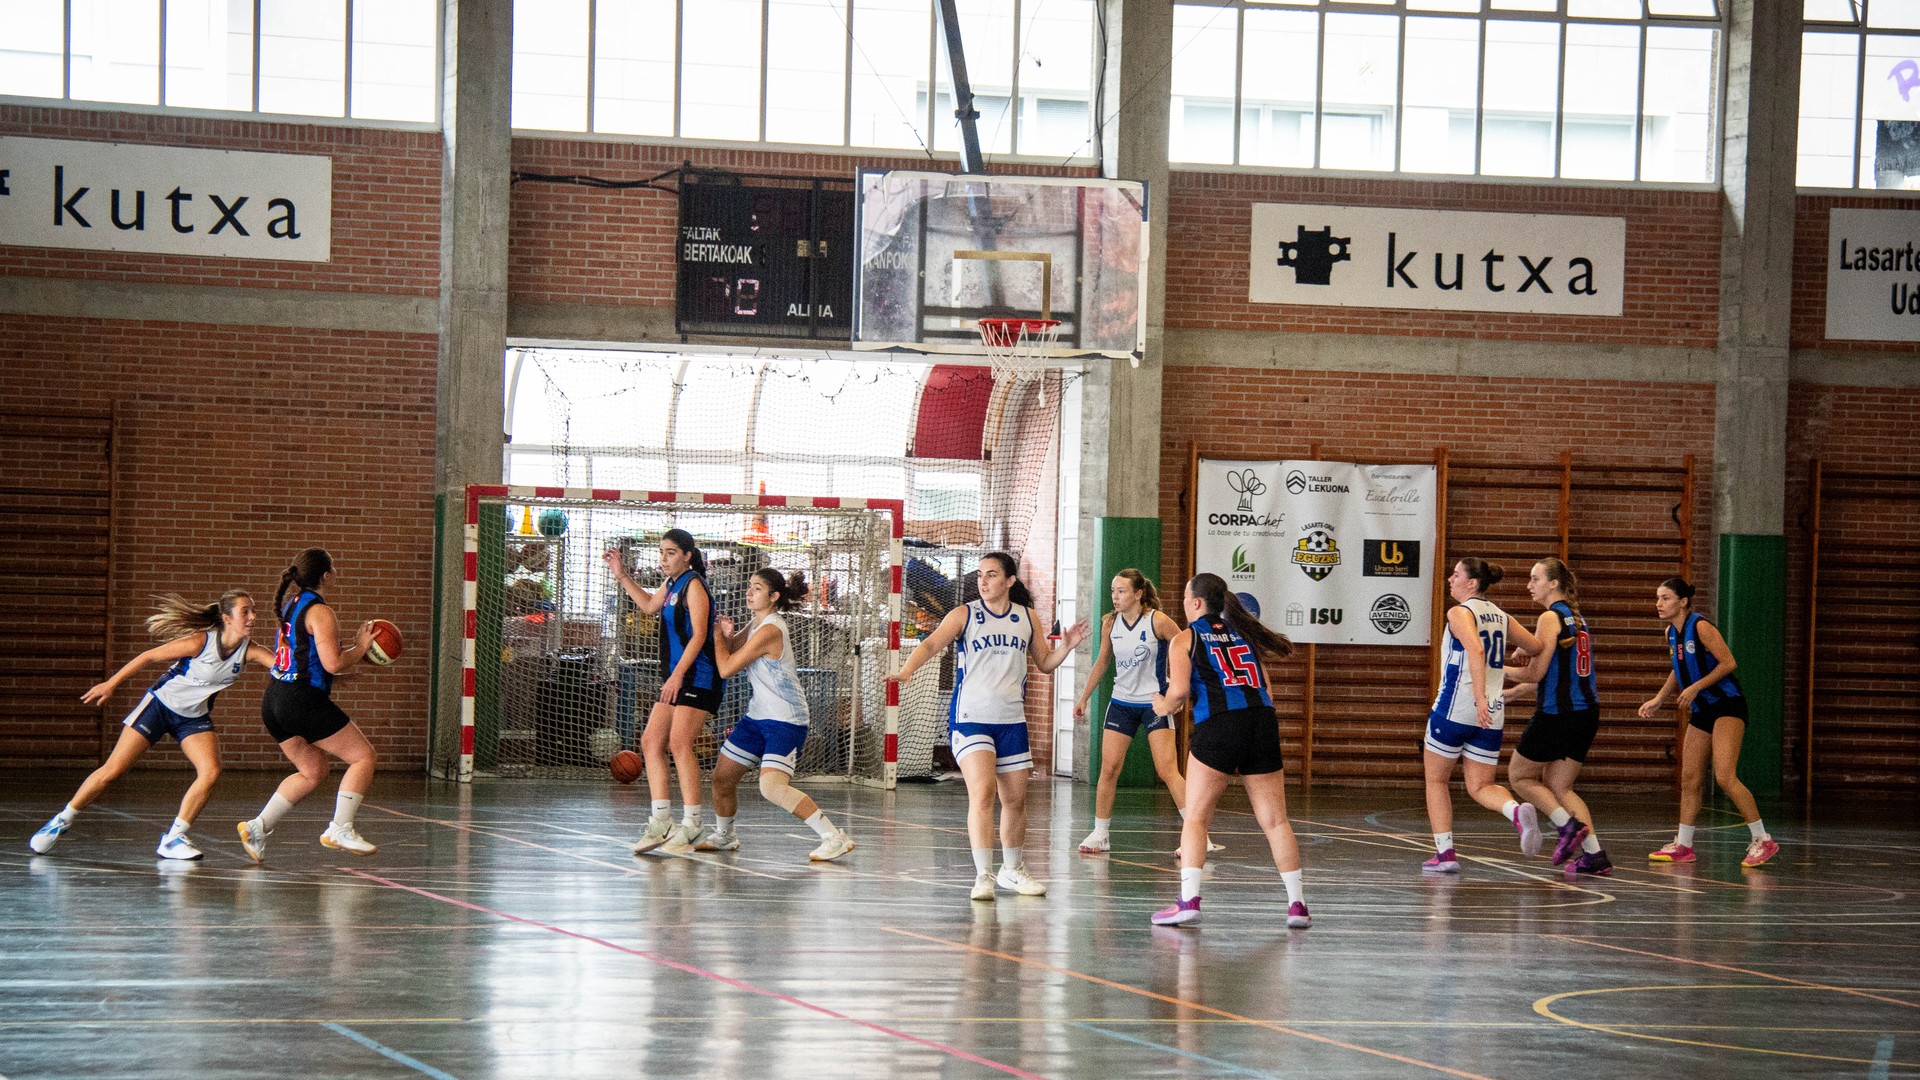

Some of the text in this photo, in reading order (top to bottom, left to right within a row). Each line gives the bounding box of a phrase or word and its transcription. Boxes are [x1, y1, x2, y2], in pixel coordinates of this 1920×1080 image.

[53, 165, 301, 239] kutxa
[684, 243, 753, 264] BERTAKOAK
[1386, 232, 1597, 296] kutxa
[786, 303, 834, 318] ALIA
[1308, 475, 1333, 483] TALLER
[1308, 484, 1350, 494] LEKUONA
[1295, 552, 1338, 564] EGUZKI
[975, 611, 986, 624] 9
[1310, 607, 1343, 625] ISU
[1372, 611, 1409, 619] AVENIDA
[1479, 613, 1503, 625] MAITE
[1139, 630, 1147, 642] 4
[971, 634, 1027, 654] AXULAR
[1576, 631, 1591, 677] 8
[232, 663, 241, 674] 5
[1210, 644, 1261, 689] 15
